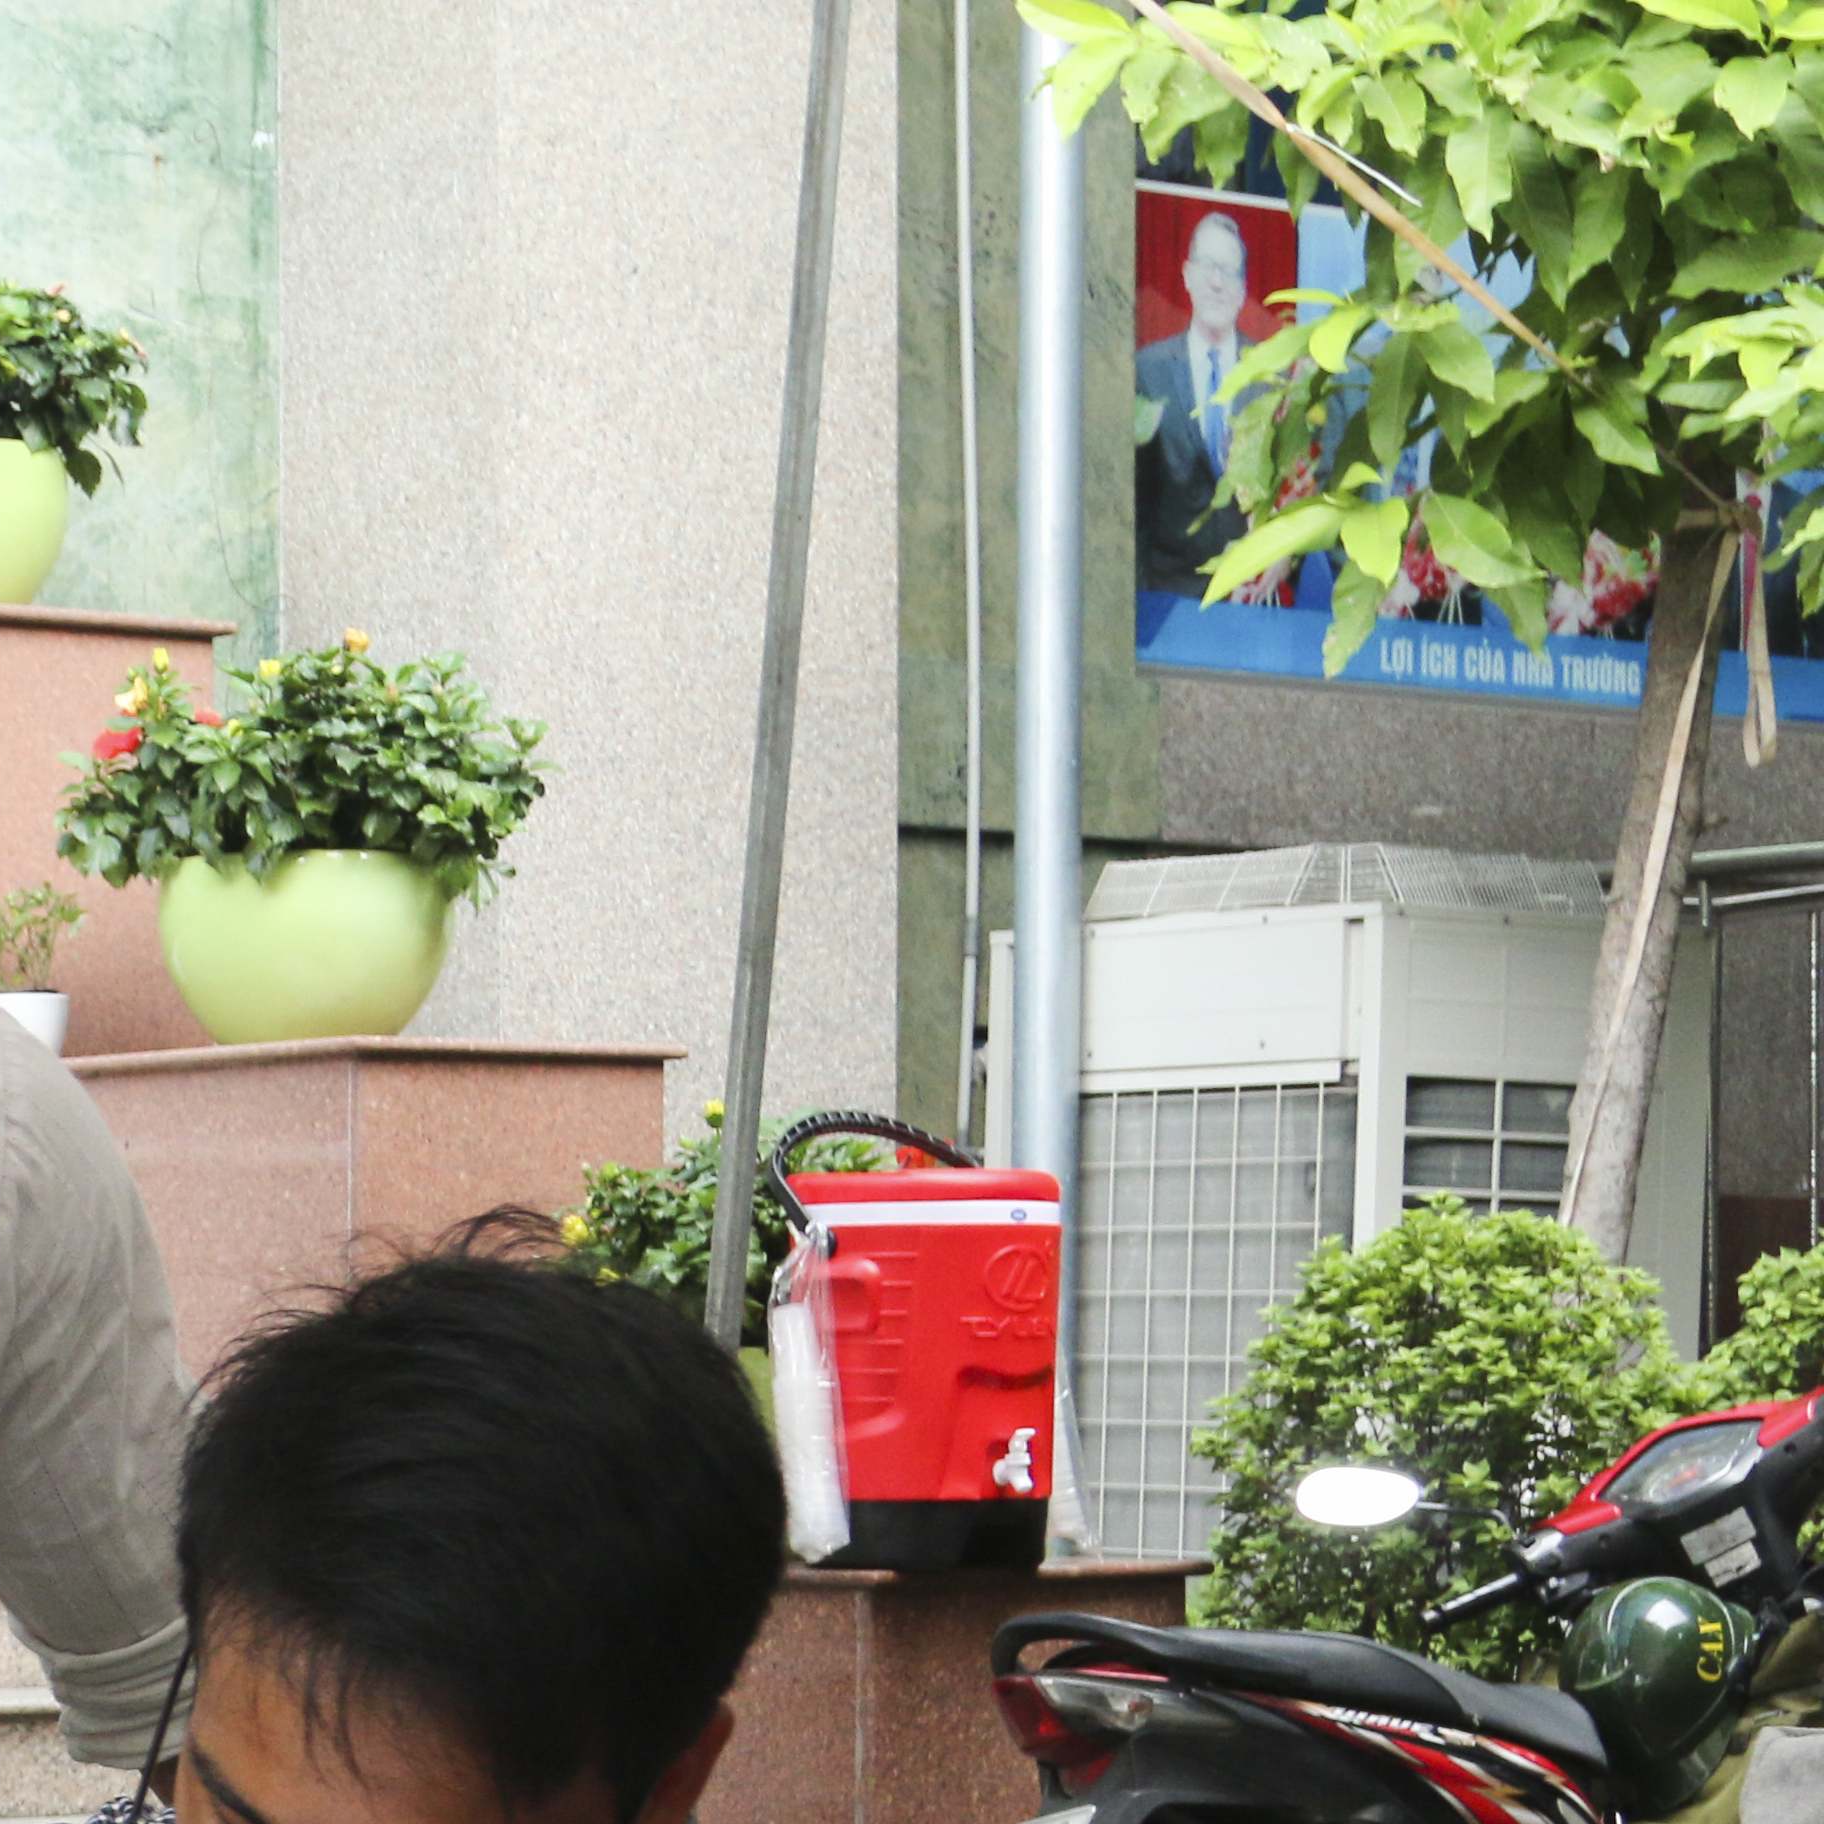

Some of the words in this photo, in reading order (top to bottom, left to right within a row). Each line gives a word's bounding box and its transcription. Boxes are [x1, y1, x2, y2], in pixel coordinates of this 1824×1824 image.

[1380, 635, 1414, 680] LỢI
[1420, 633, 1458, 680] ÍCH
[1464, 636, 1506, 684] CỦA
[1561, 651, 1642, 696] TRƯỜNG
